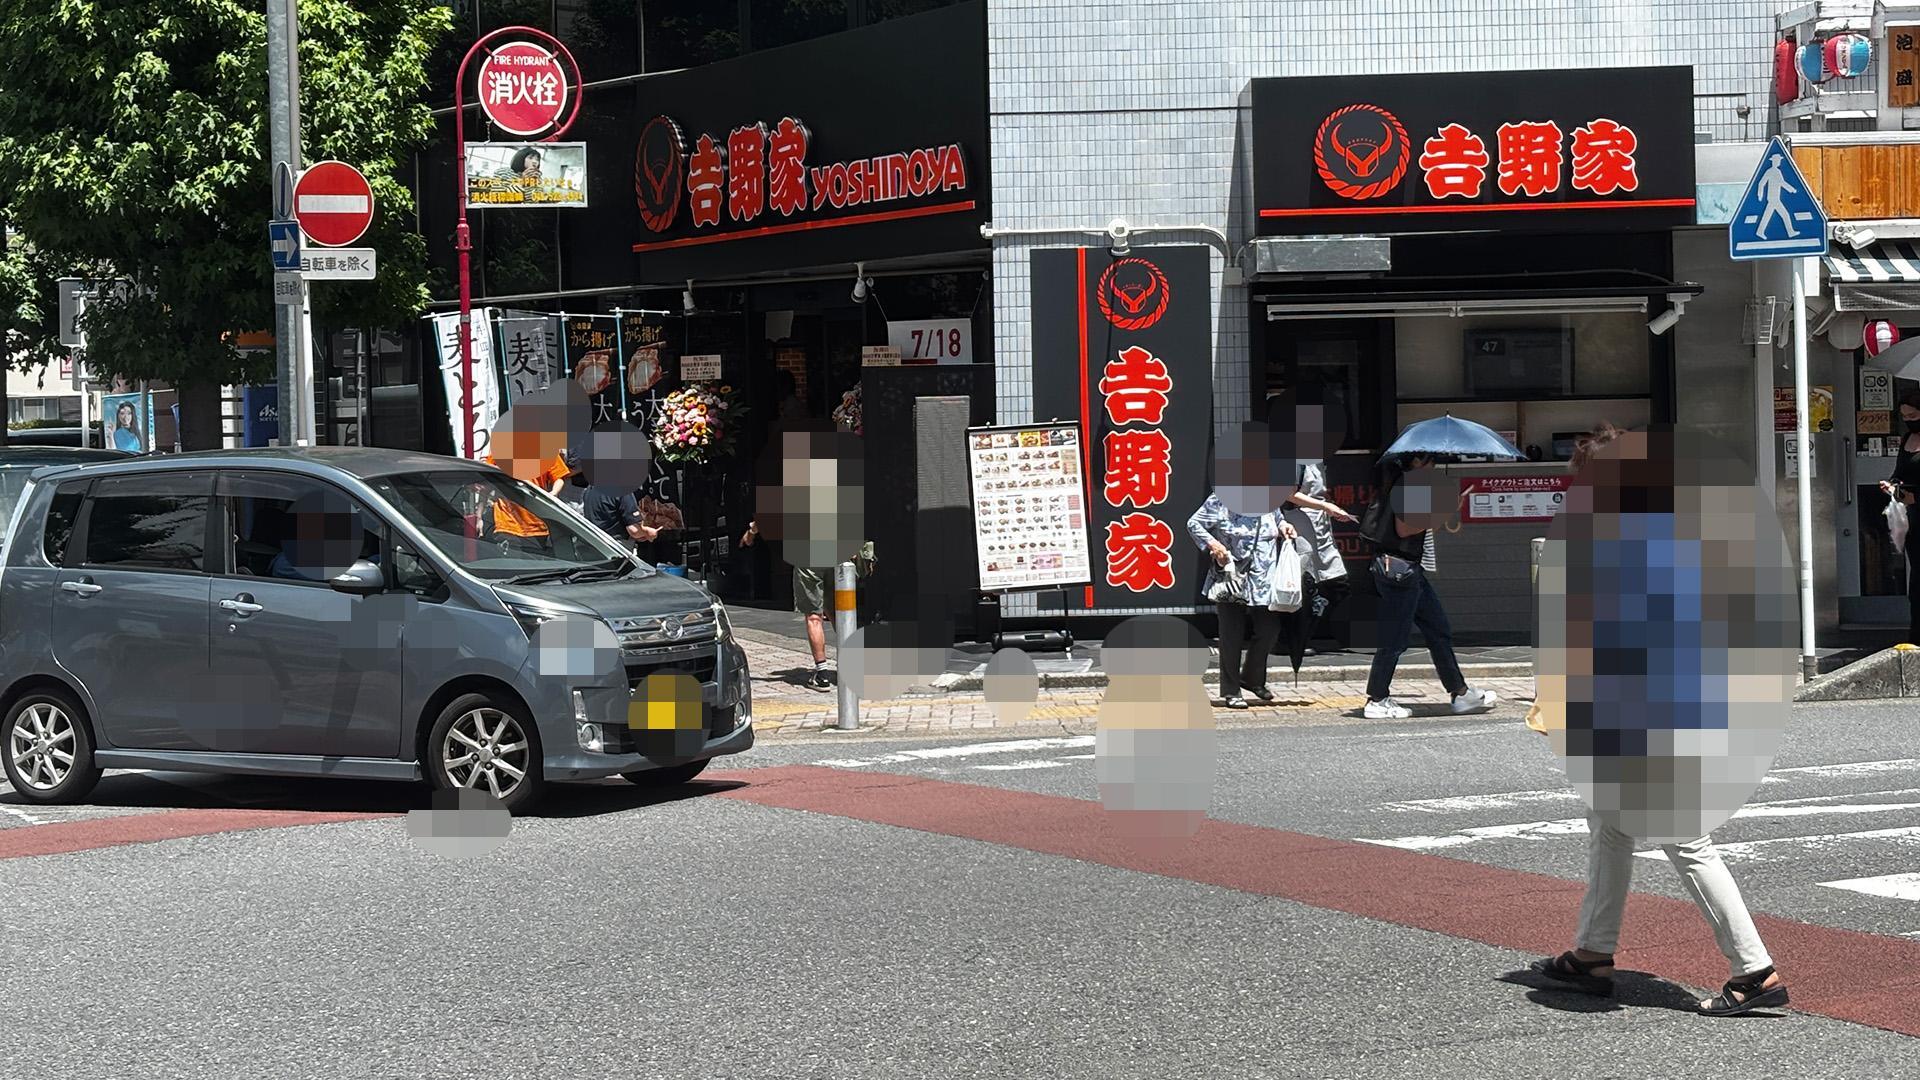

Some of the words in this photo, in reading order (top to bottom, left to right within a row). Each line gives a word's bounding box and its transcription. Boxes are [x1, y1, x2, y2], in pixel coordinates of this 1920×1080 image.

[493, 55, 512, 66] FIRE
[513, 55, 550, 67] HYDRANT
[488, 71, 559, 106] 消火栓
[812, 143, 967, 212] YOSHINOYA
[301, 256, 370, 272] 自転車を除く
[571, 331, 616, 348] から揚げ
[625, 325, 663, 343] から揚げ
[911, 328, 962, 358] 7/18
[1482, 341, 1499, 352] 47
